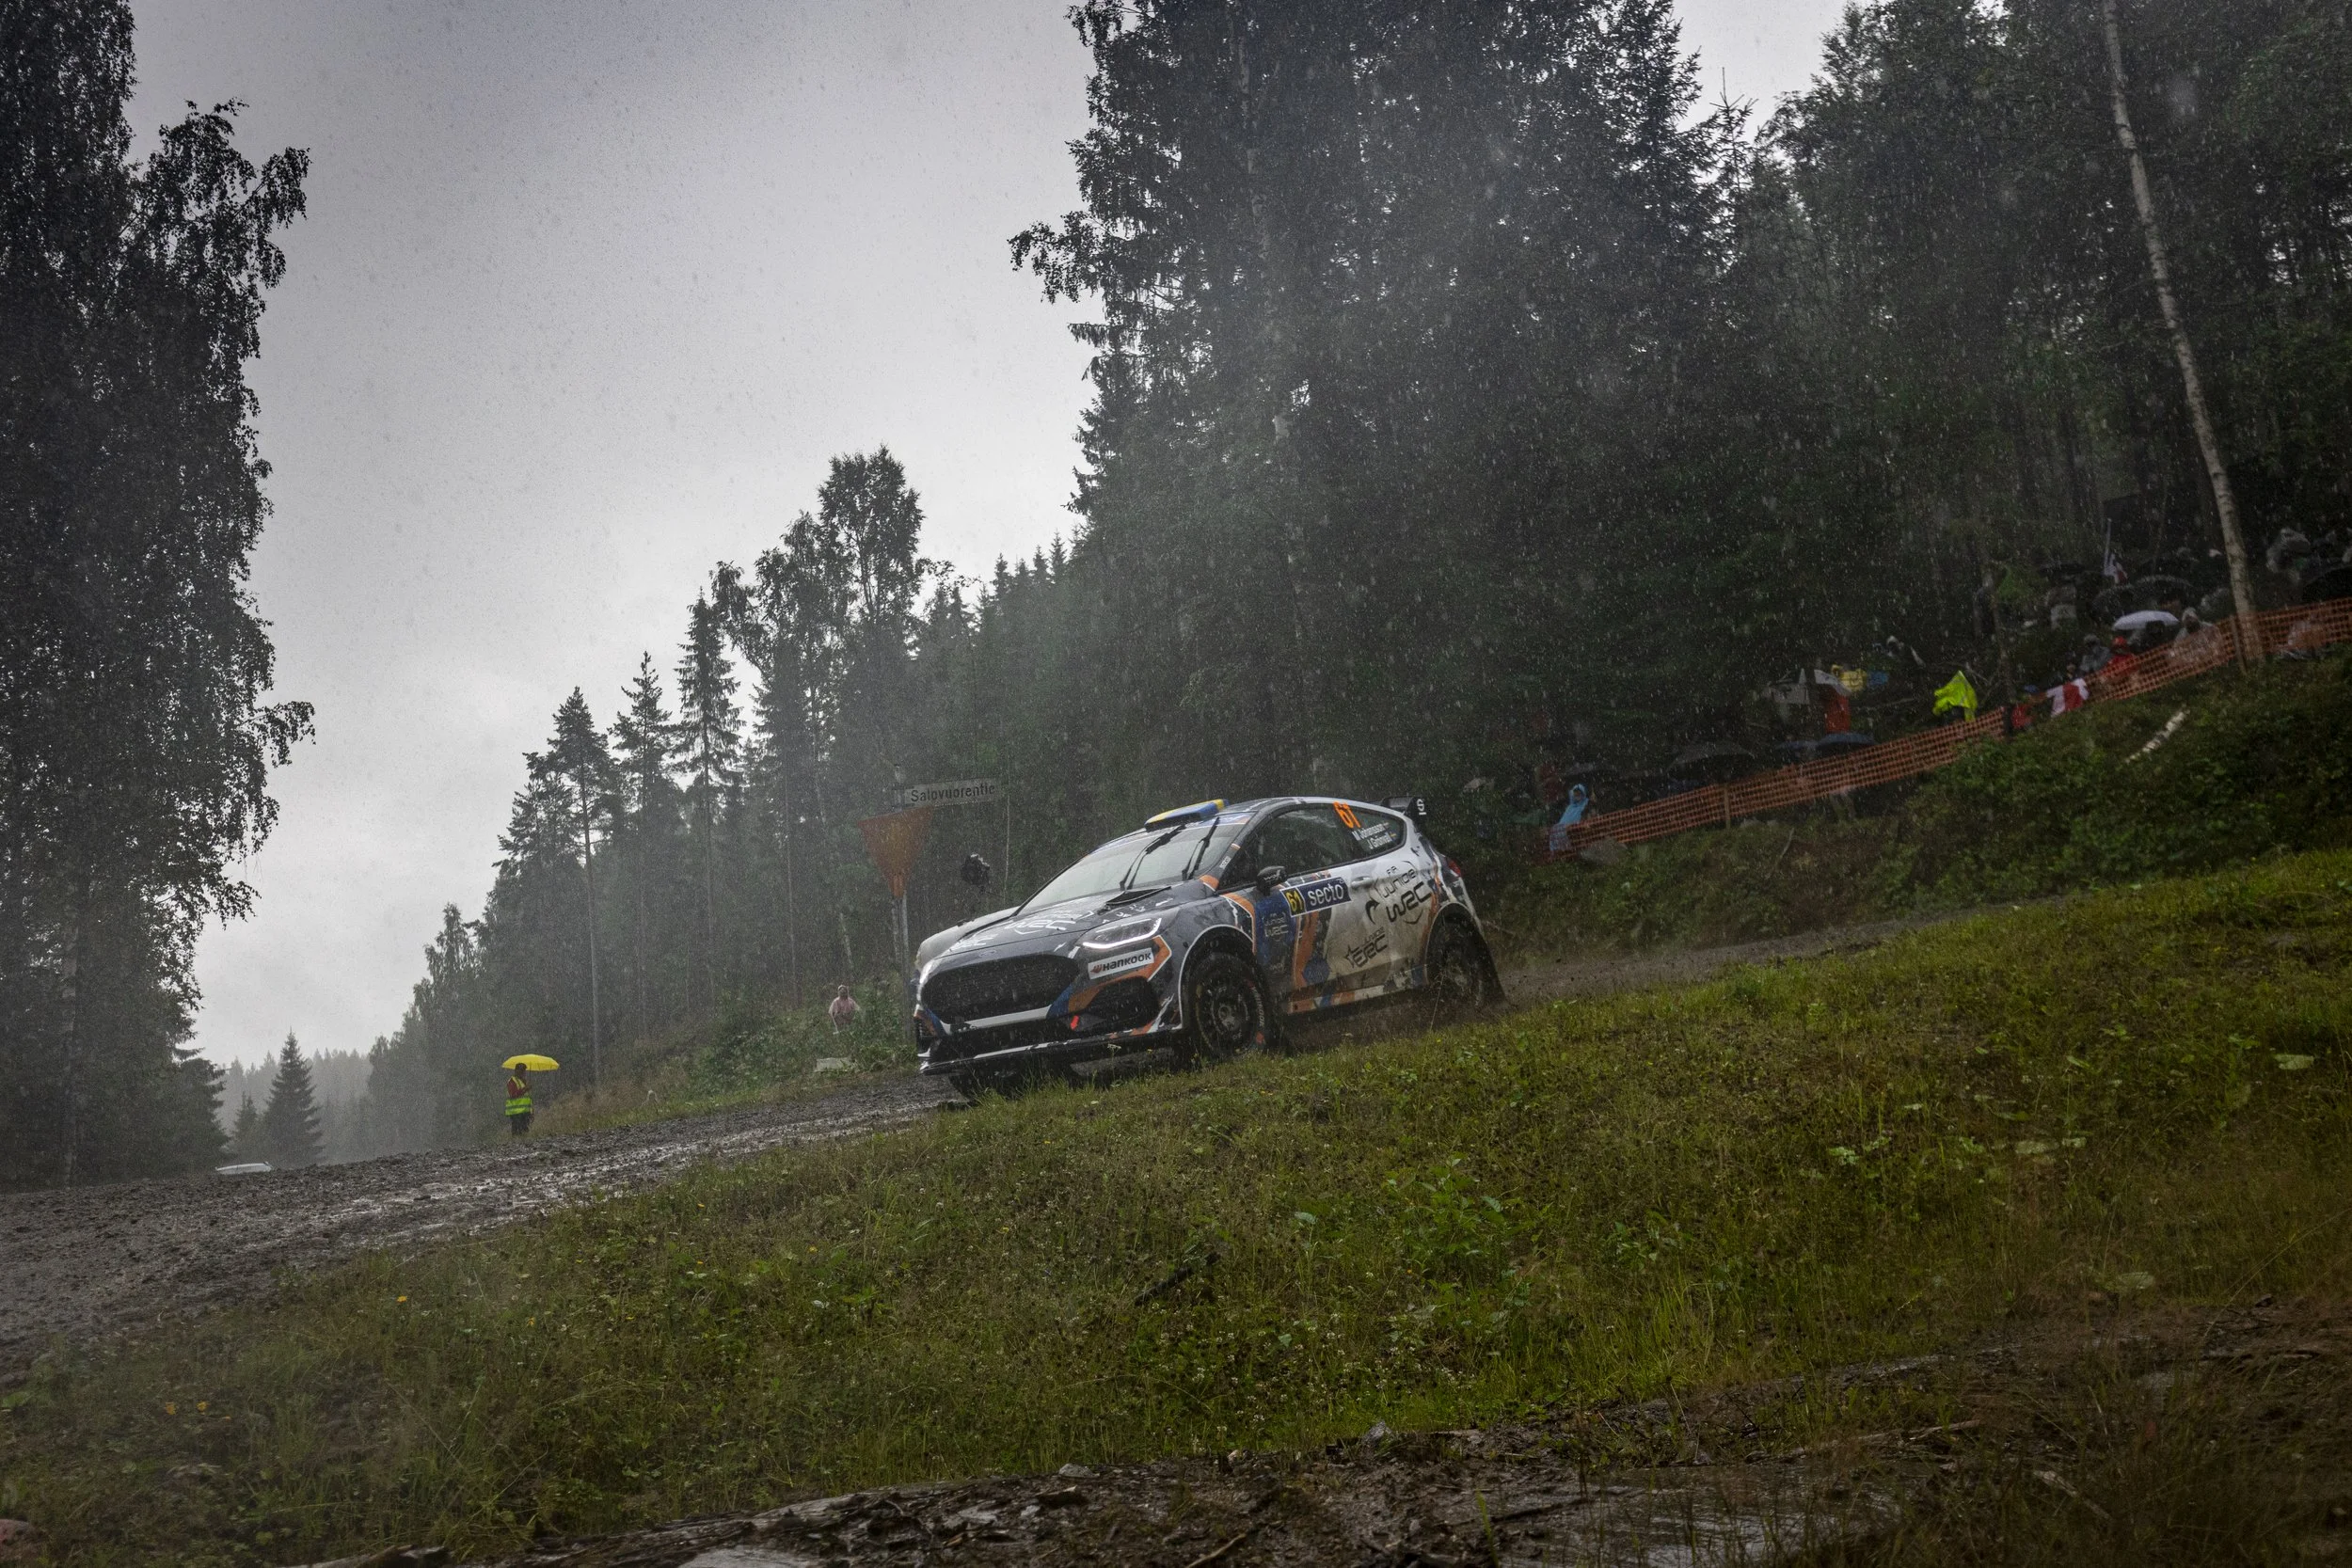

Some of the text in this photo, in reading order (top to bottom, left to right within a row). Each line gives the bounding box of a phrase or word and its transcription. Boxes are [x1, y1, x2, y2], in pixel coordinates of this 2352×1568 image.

[911, 783, 995, 802] Salovuorentie
[1333, 801, 1361, 829] 61
[1286, 883, 1343, 911] 61 secto
[1386, 881, 1432, 923] WRC
